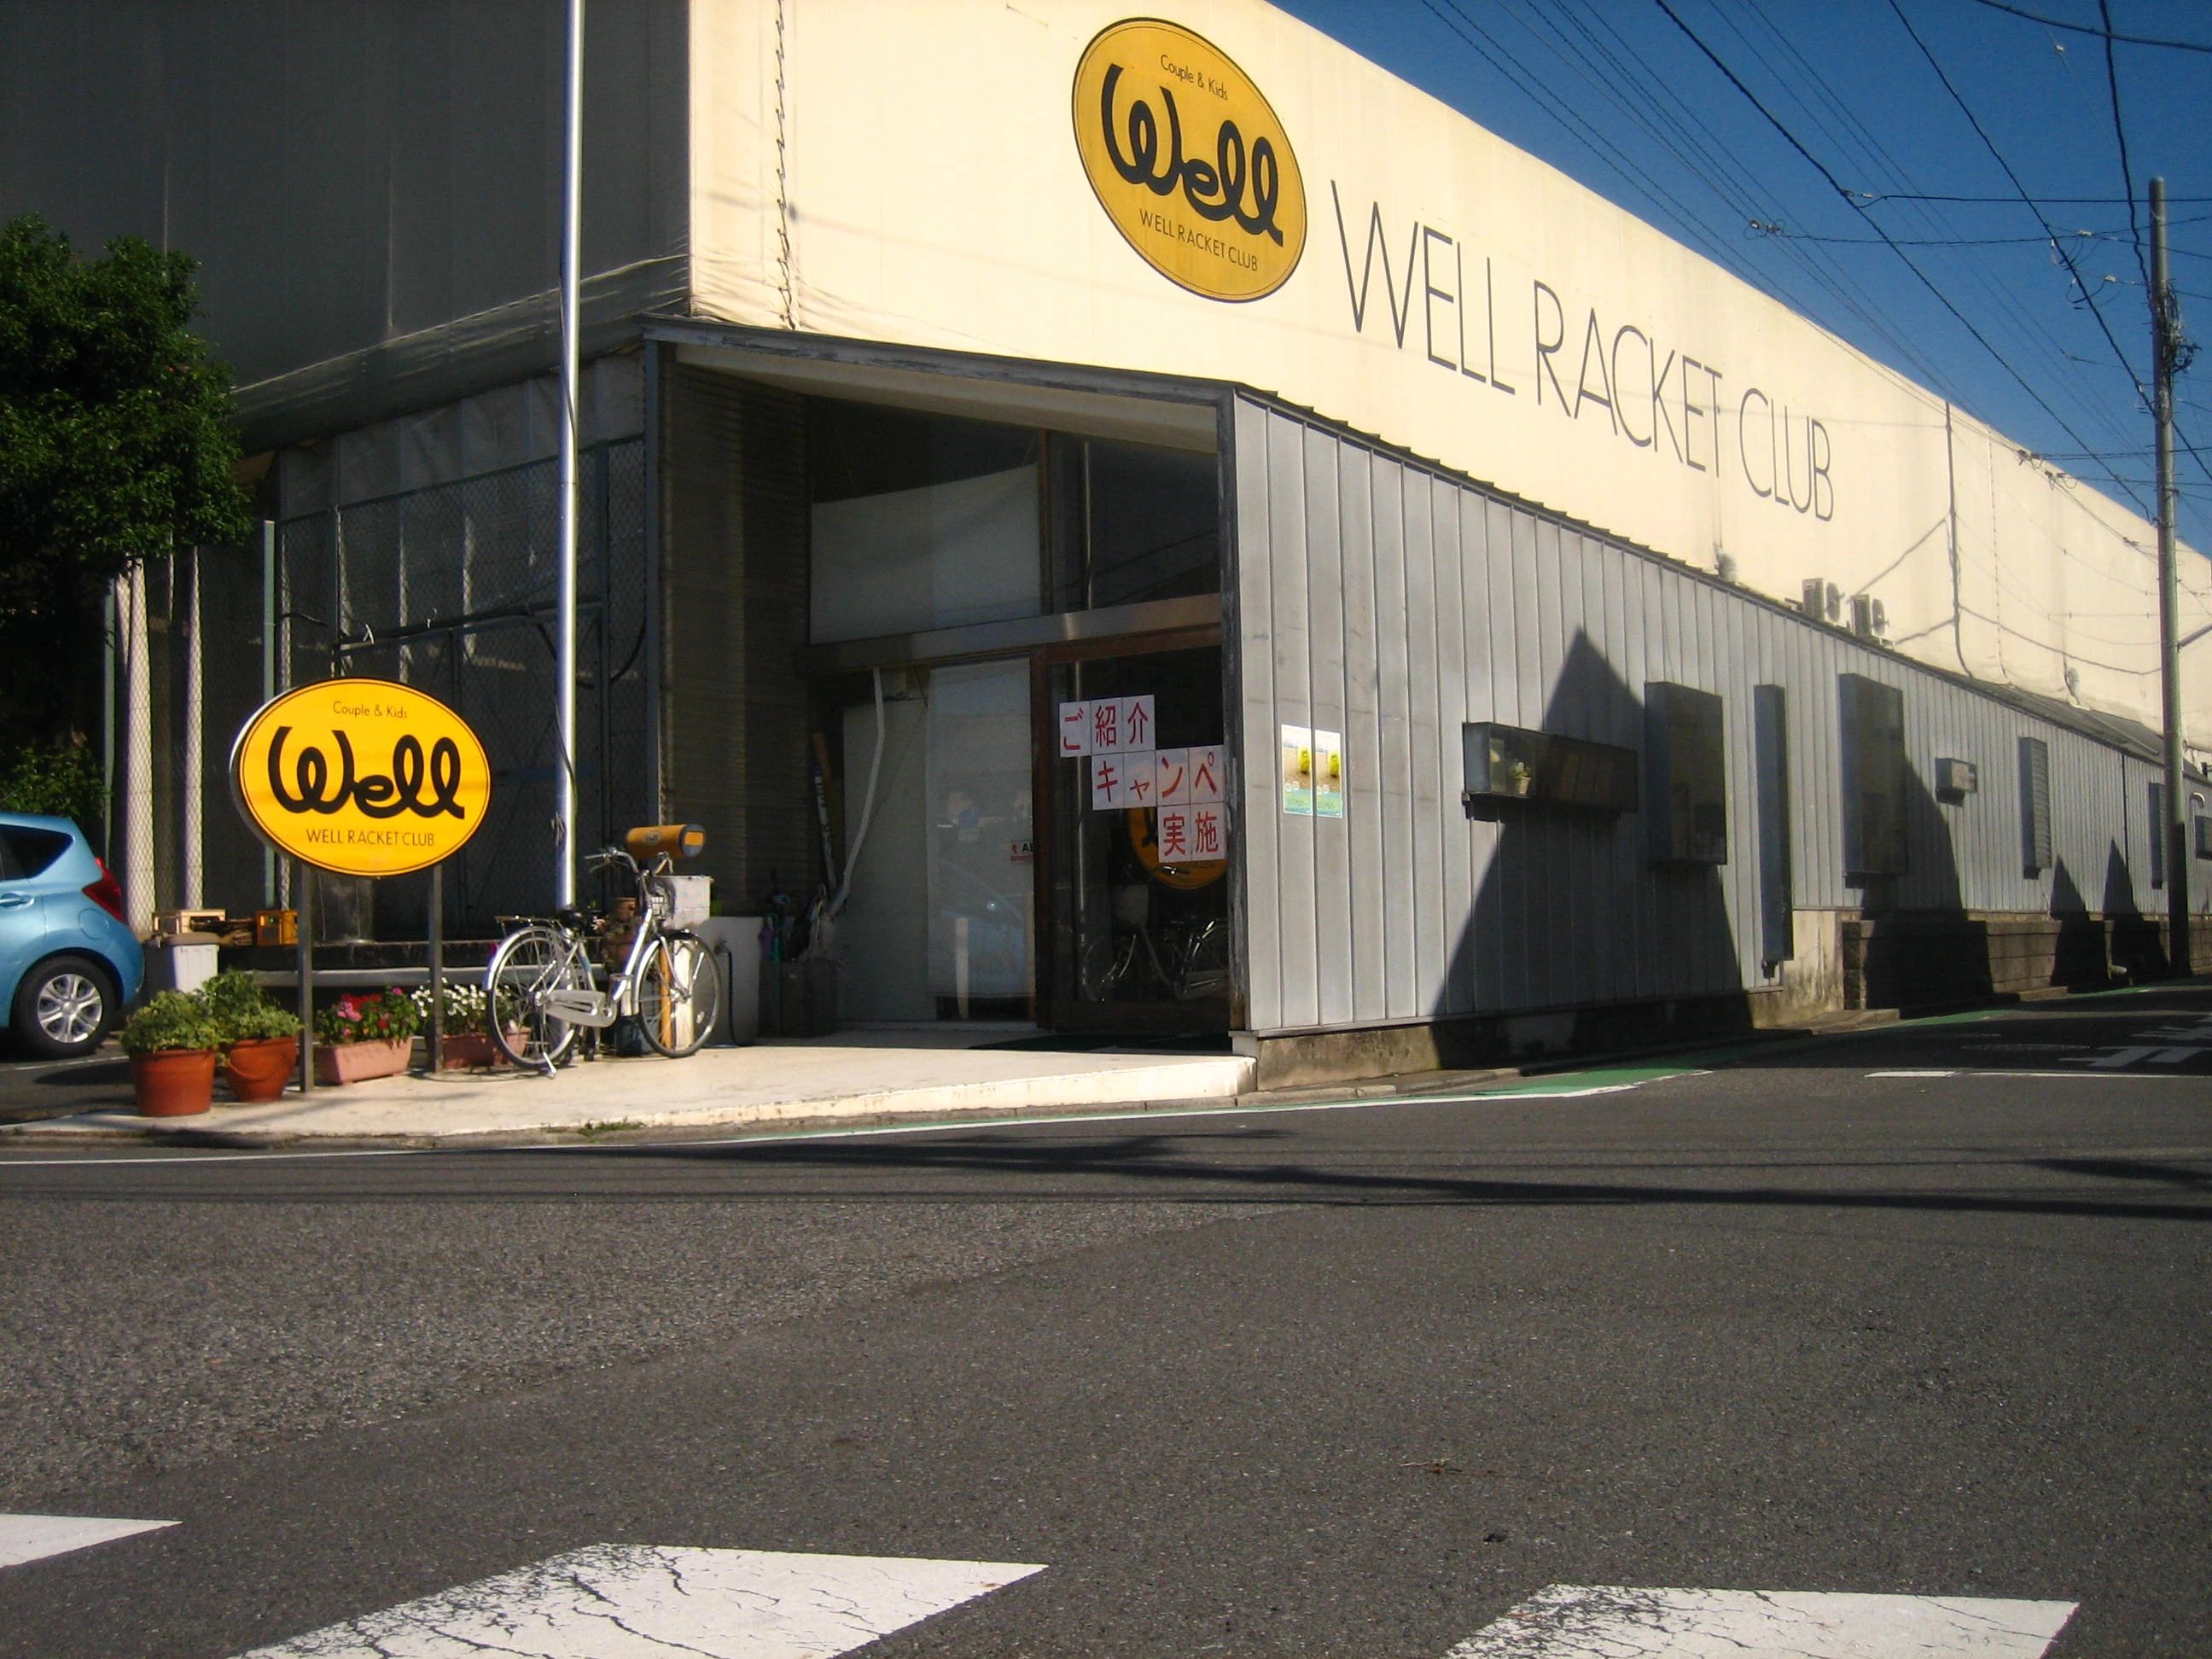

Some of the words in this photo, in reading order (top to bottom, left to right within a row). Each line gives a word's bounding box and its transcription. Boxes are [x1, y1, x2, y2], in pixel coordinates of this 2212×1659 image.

[1161, 54, 1194, 84] Couple
[1197, 73, 1204, 88] &
[1208, 78, 1228, 101] Kids
[1101, 63, 1284, 247] Well
[1139, 209, 1175, 239] WELL
[1179, 224, 1225, 259] RACKET
[1229, 246, 1258, 271] CLUB
[1331, 179, 1515, 395] WELL
[1534, 279, 1722, 478] RACKET
[1739, 387, 1834, 521] CLUB
[333, 701, 370, 718] Couple
[374, 705, 382, 717] &
[387, 706, 407, 719] Kids
[1063, 701, 1148, 750] ご紹介
[268, 726, 465, 819] Well
[1097, 752, 1218, 802] キャンペ
[306, 829, 344, 844] WELL
[348, 830, 399, 846] RACKET
[402, 832, 434, 847] CLUB
[1163, 812, 1219, 857] 実施
